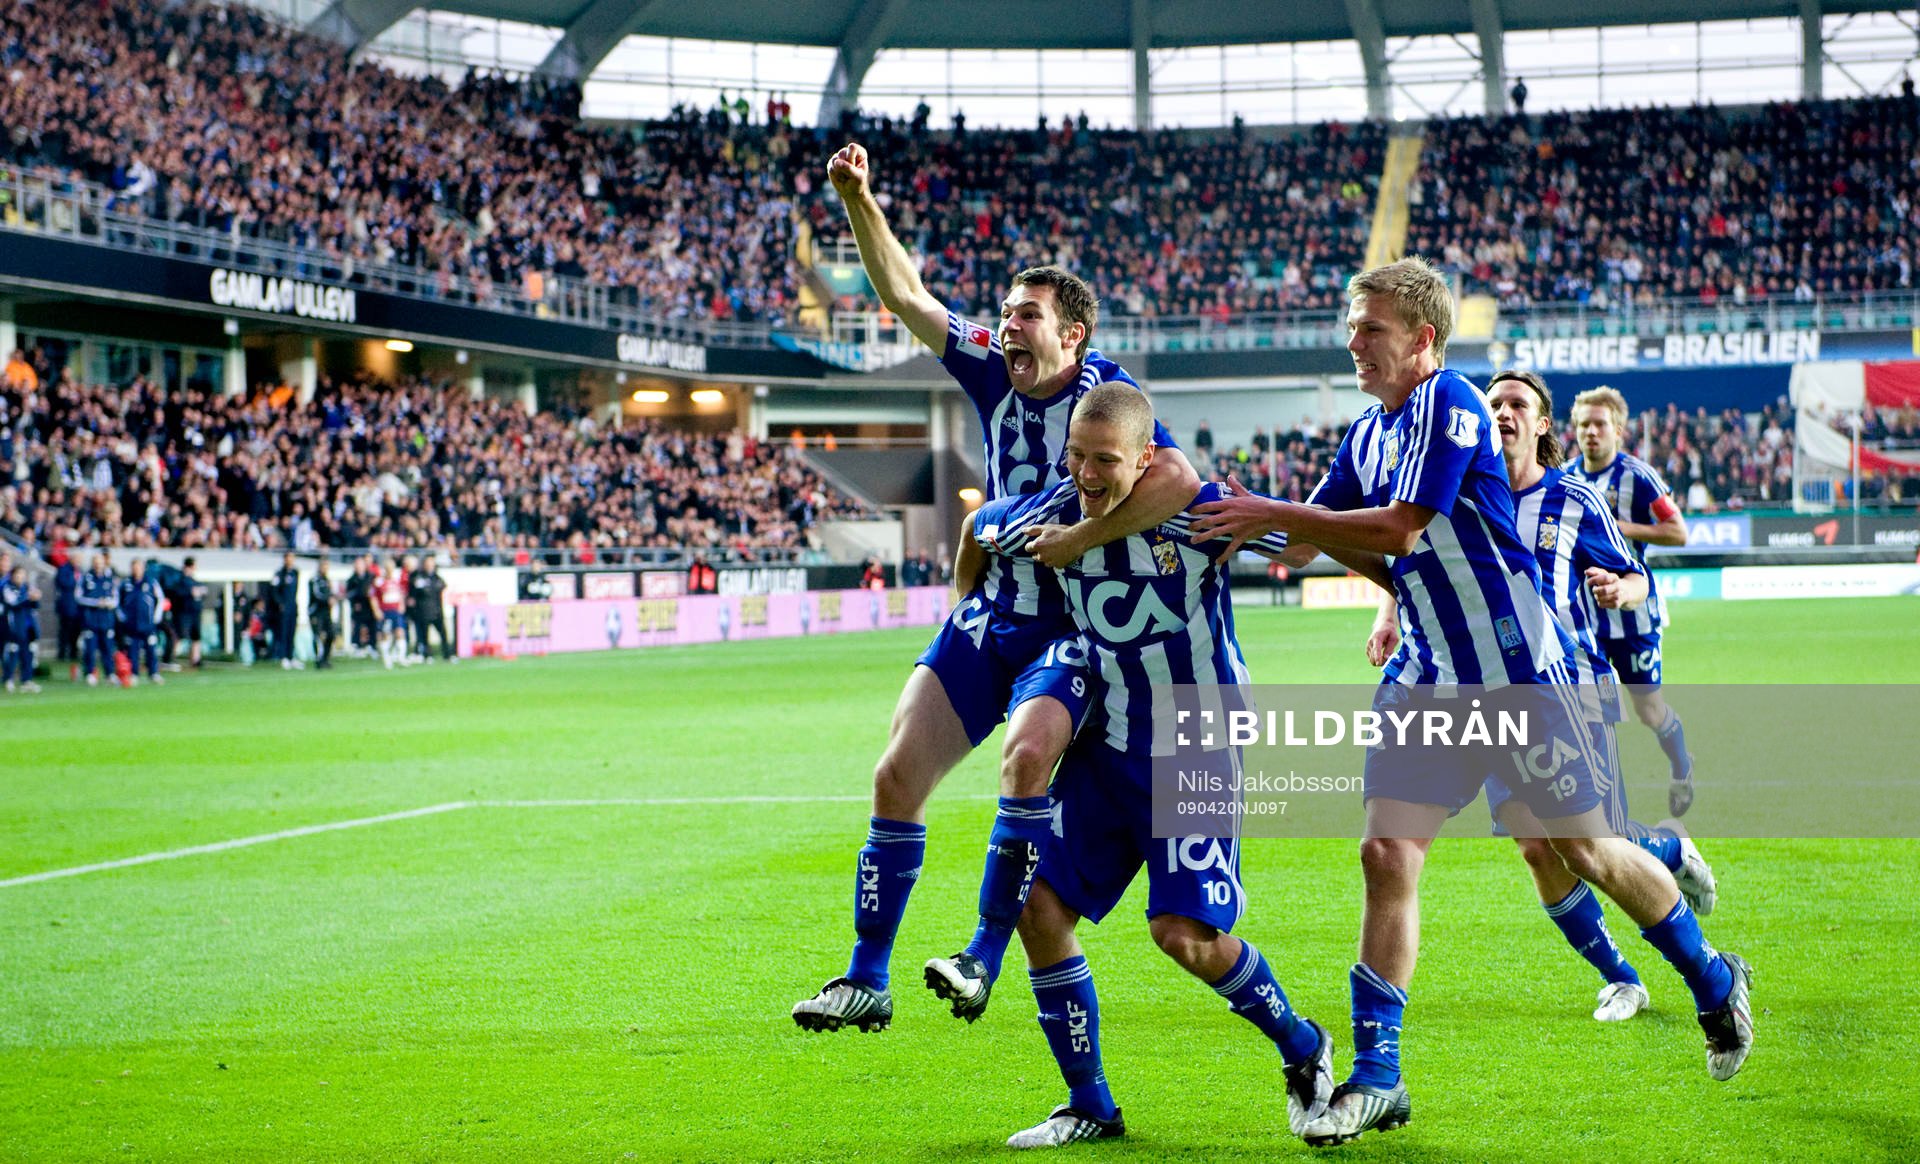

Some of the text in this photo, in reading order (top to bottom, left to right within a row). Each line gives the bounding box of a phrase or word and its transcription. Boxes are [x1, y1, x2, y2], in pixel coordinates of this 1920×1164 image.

[210, 268, 356, 323] GAMLA ULLEVI
[1514, 336, 1638, 370] SVERIGE
[1664, 330, 1820, 366] BRASILIEN
[1025, 410, 1042, 424] ICA
[1688, 522, 1740, 545] AR
[952, 597, 990, 650] CA
[1068, 580, 1187, 643] ICA
[1043, 640, 1089, 667] IC
[1630, 647, 1661, 673] ICA
[1070, 676, 1086, 698] 9
[1511, 736, 1580, 784] ICA
[1547, 774, 1577, 802] 19
[1018, 842, 1040, 904] SKF
[1167, 833, 1230, 875] ICA
[860, 853, 880, 911] SKF
[1202, 880, 1231, 905] 10
[1254, 983, 1285, 1019] SKF
[1066, 1000, 1091, 1053] SKF
